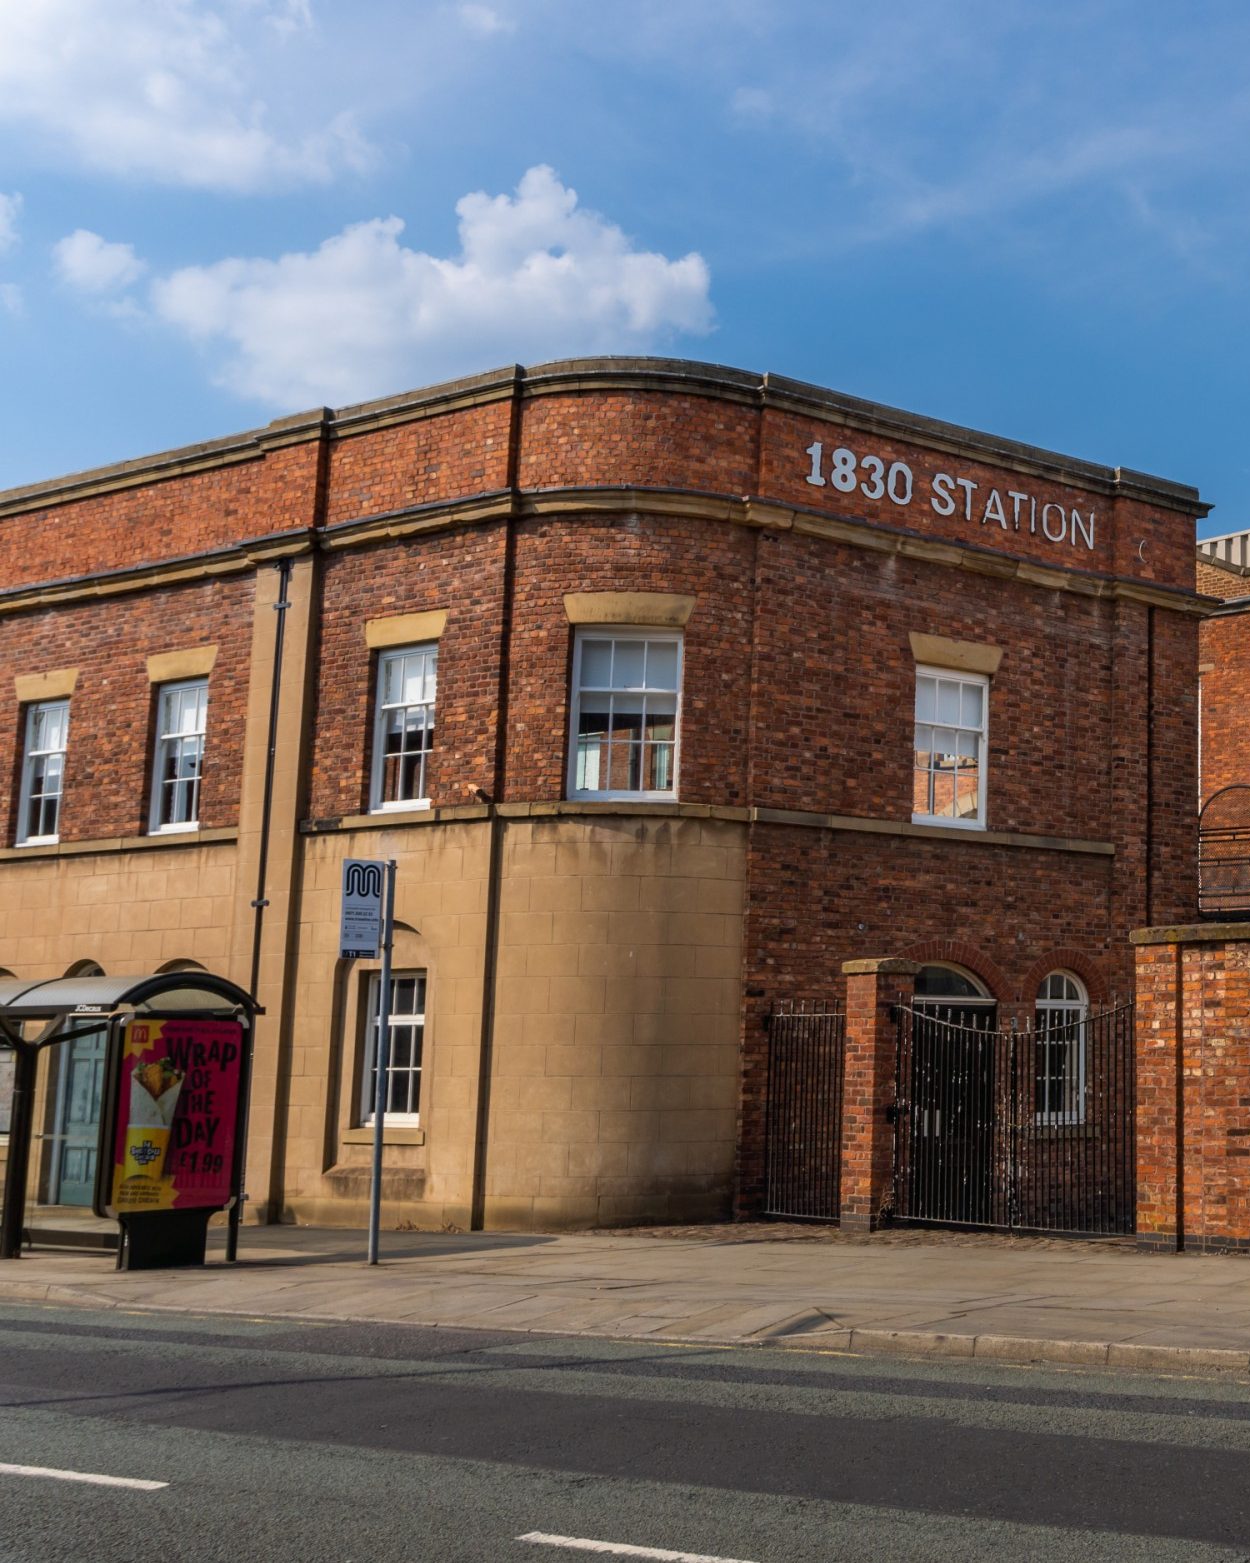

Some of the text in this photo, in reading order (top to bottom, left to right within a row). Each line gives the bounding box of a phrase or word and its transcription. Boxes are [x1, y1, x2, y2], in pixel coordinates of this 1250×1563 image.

[806, 441, 1096, 550] 1830 STATION
[166, 1036, 237, 1072] WRAP
[191, 1069, 211, 1089] OF
[181, 1090, 216, 1115] THE
[176, 1117, 220, 1149] DAY
